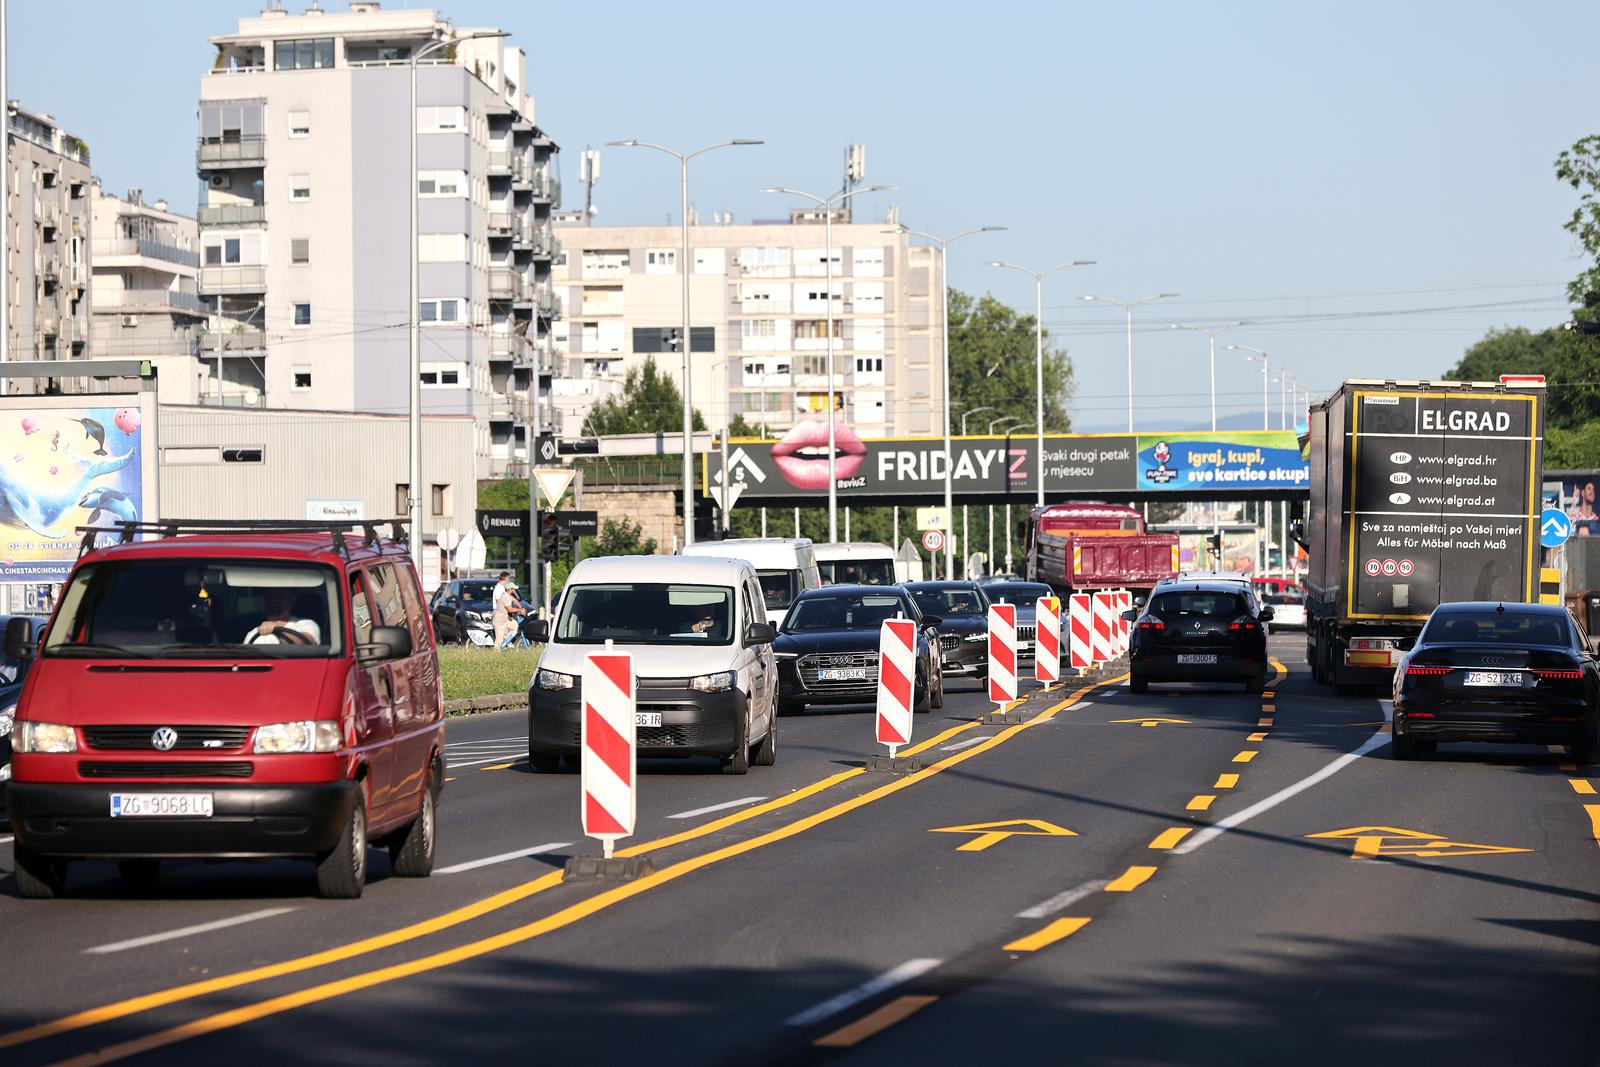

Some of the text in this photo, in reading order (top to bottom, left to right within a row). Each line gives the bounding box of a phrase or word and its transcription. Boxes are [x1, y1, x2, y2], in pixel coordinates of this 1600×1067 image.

[1422, 409, 1510, 432] ELGRAD
[1042, 448, 1130, 463] Svaki drugi petak
[1228, 448, 1265, 465] kupi,
[1395, 454, 1407, 462] HR
[1418, 454, 1497, 466] www.elgrad.hr
[734, 466, 746, 481] 5
[1051, 465, 1094, 478] mjesecu
[1187, 466, 1309, 484] sve kartice skupi
[1416, 474, 1497, 486] www.elgrad.ba
[1417, 494, 1496, 507] www.elgrad.at
[490, 518, 521, 527] RENAULT
[1362, 522, 1522, 536] Sve za namještaj po Vašoj mjeri
[39, 541, 73, 549] SVIBNJA
[927, 535, 940, 545] 40
[1377, 537, 1507, 550] Alles für Möbel nach Maß
[4, 567, 72, 575] CINESTARCINEMAS.H
[1369, 563, 1378, 572] 70
[1385, 563, 1394, 572] 80
[1401, 563, 1410, 572] 90
[823, 670, 833, 679] ZG
[1470, 673, 1481, 683] ZG
[636, 714, 661, 725] 36-IR
[122, 797, 141, 814] ZG
